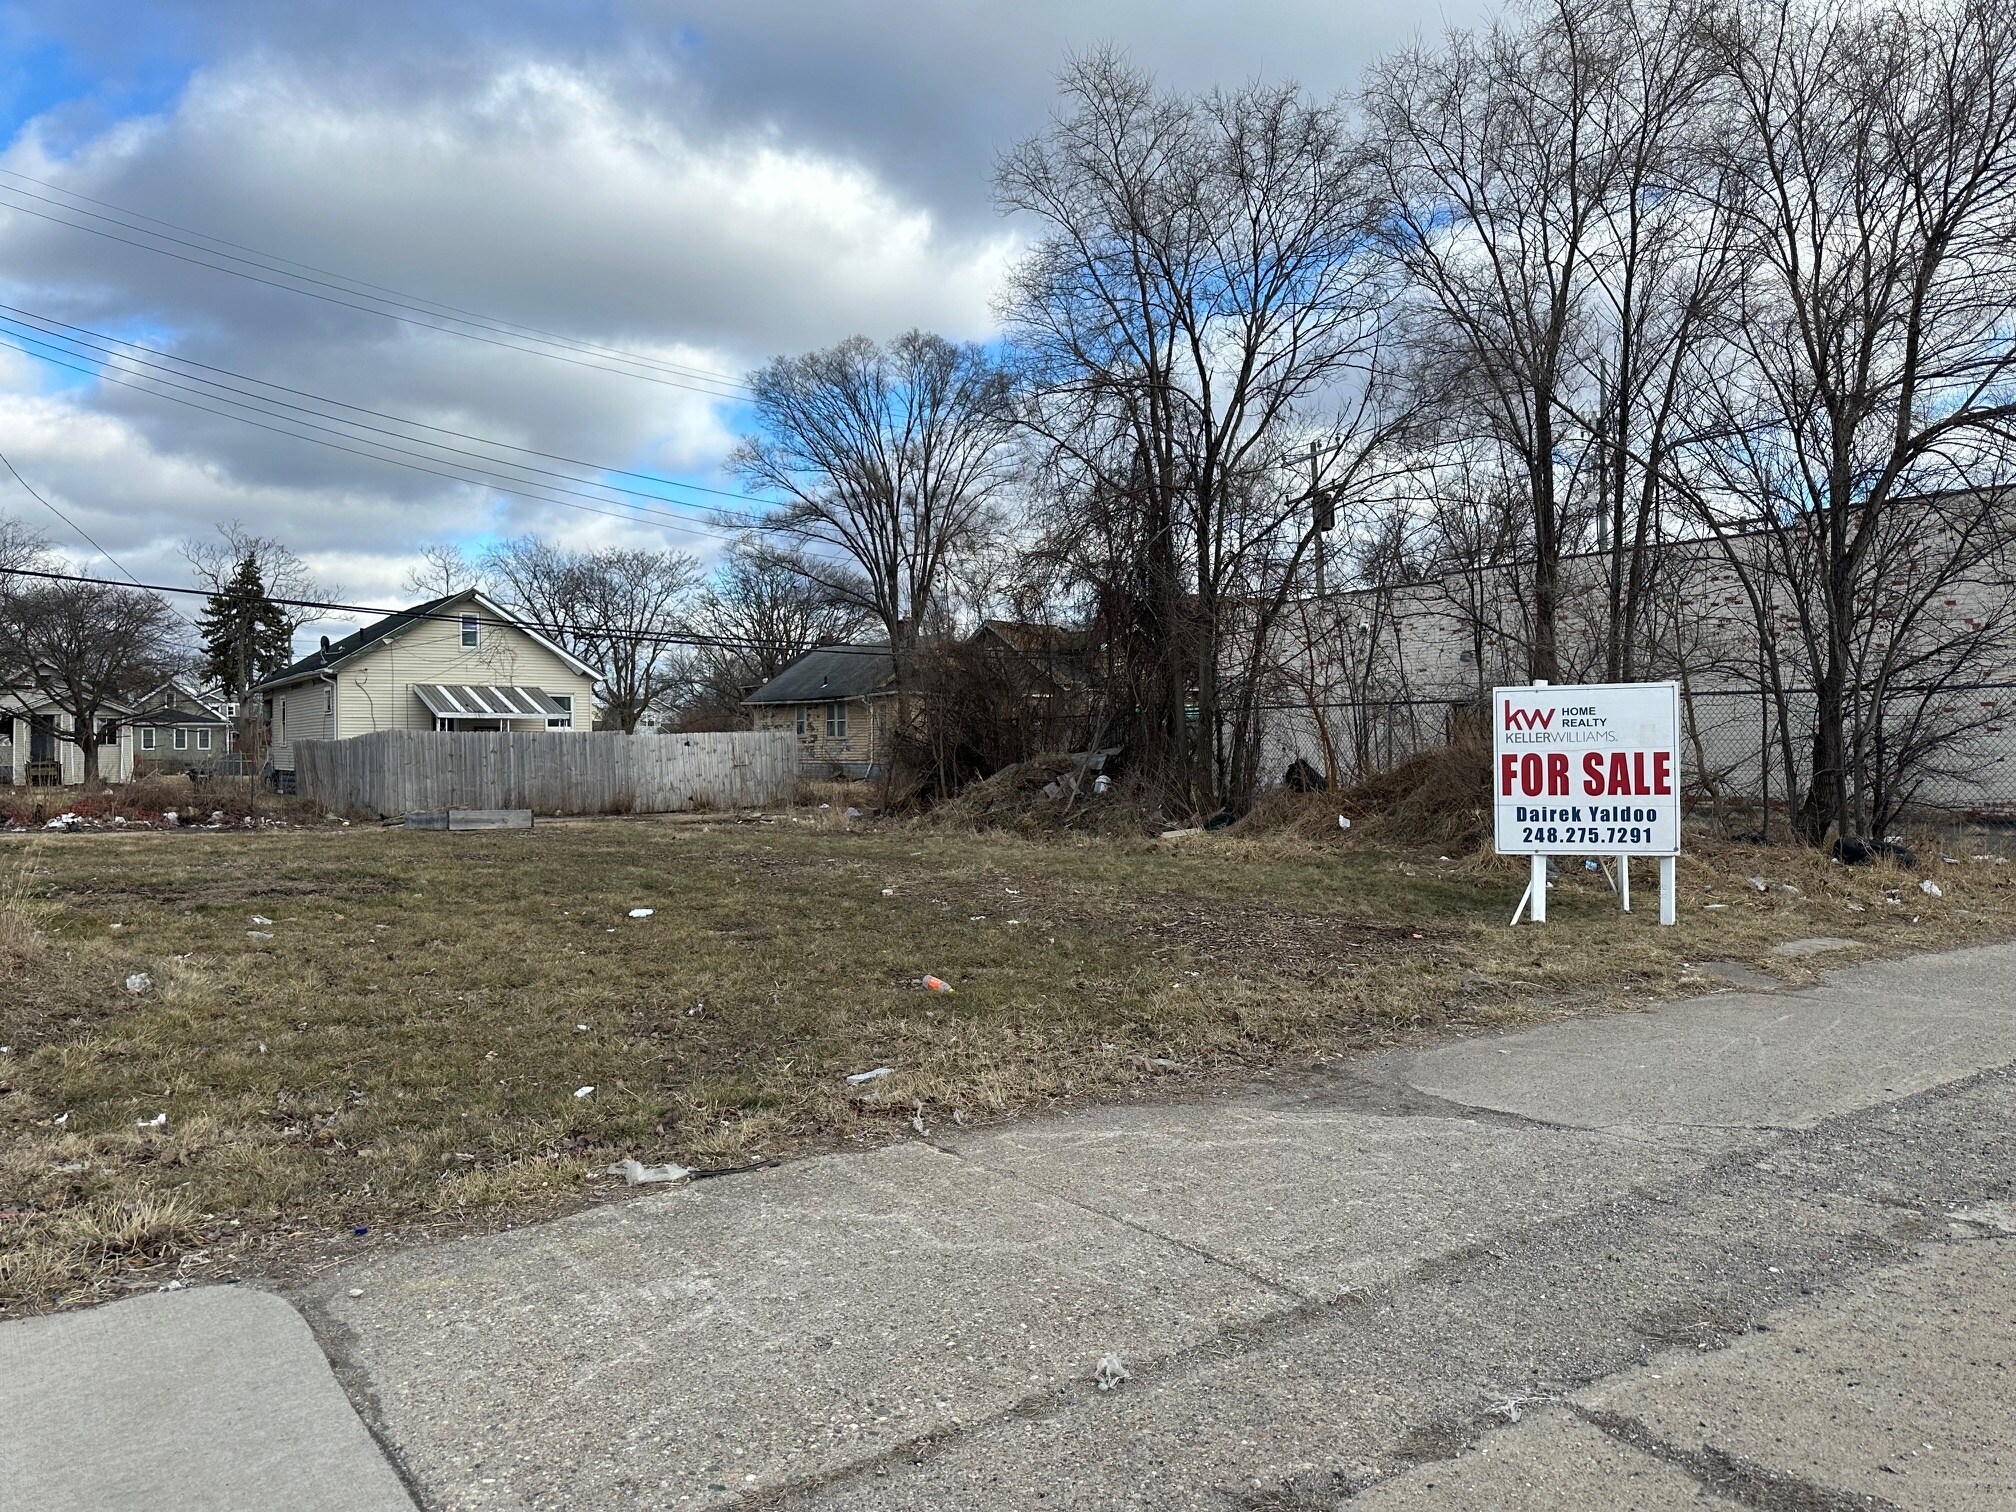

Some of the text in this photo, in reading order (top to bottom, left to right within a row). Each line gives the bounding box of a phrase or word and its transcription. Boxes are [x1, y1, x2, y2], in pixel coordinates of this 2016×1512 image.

[1505, 700, 1555, 730] kw
[1562, 707, 1596, 716] HOME
[1562, 718, 1607, 727] REALTY
[1502, 752, 1671, 797] FOR SALE
[1517, 806, 1657, 822] Dairek Yaldoo
[1522, 827, 1651, 843] 248.275.7291
